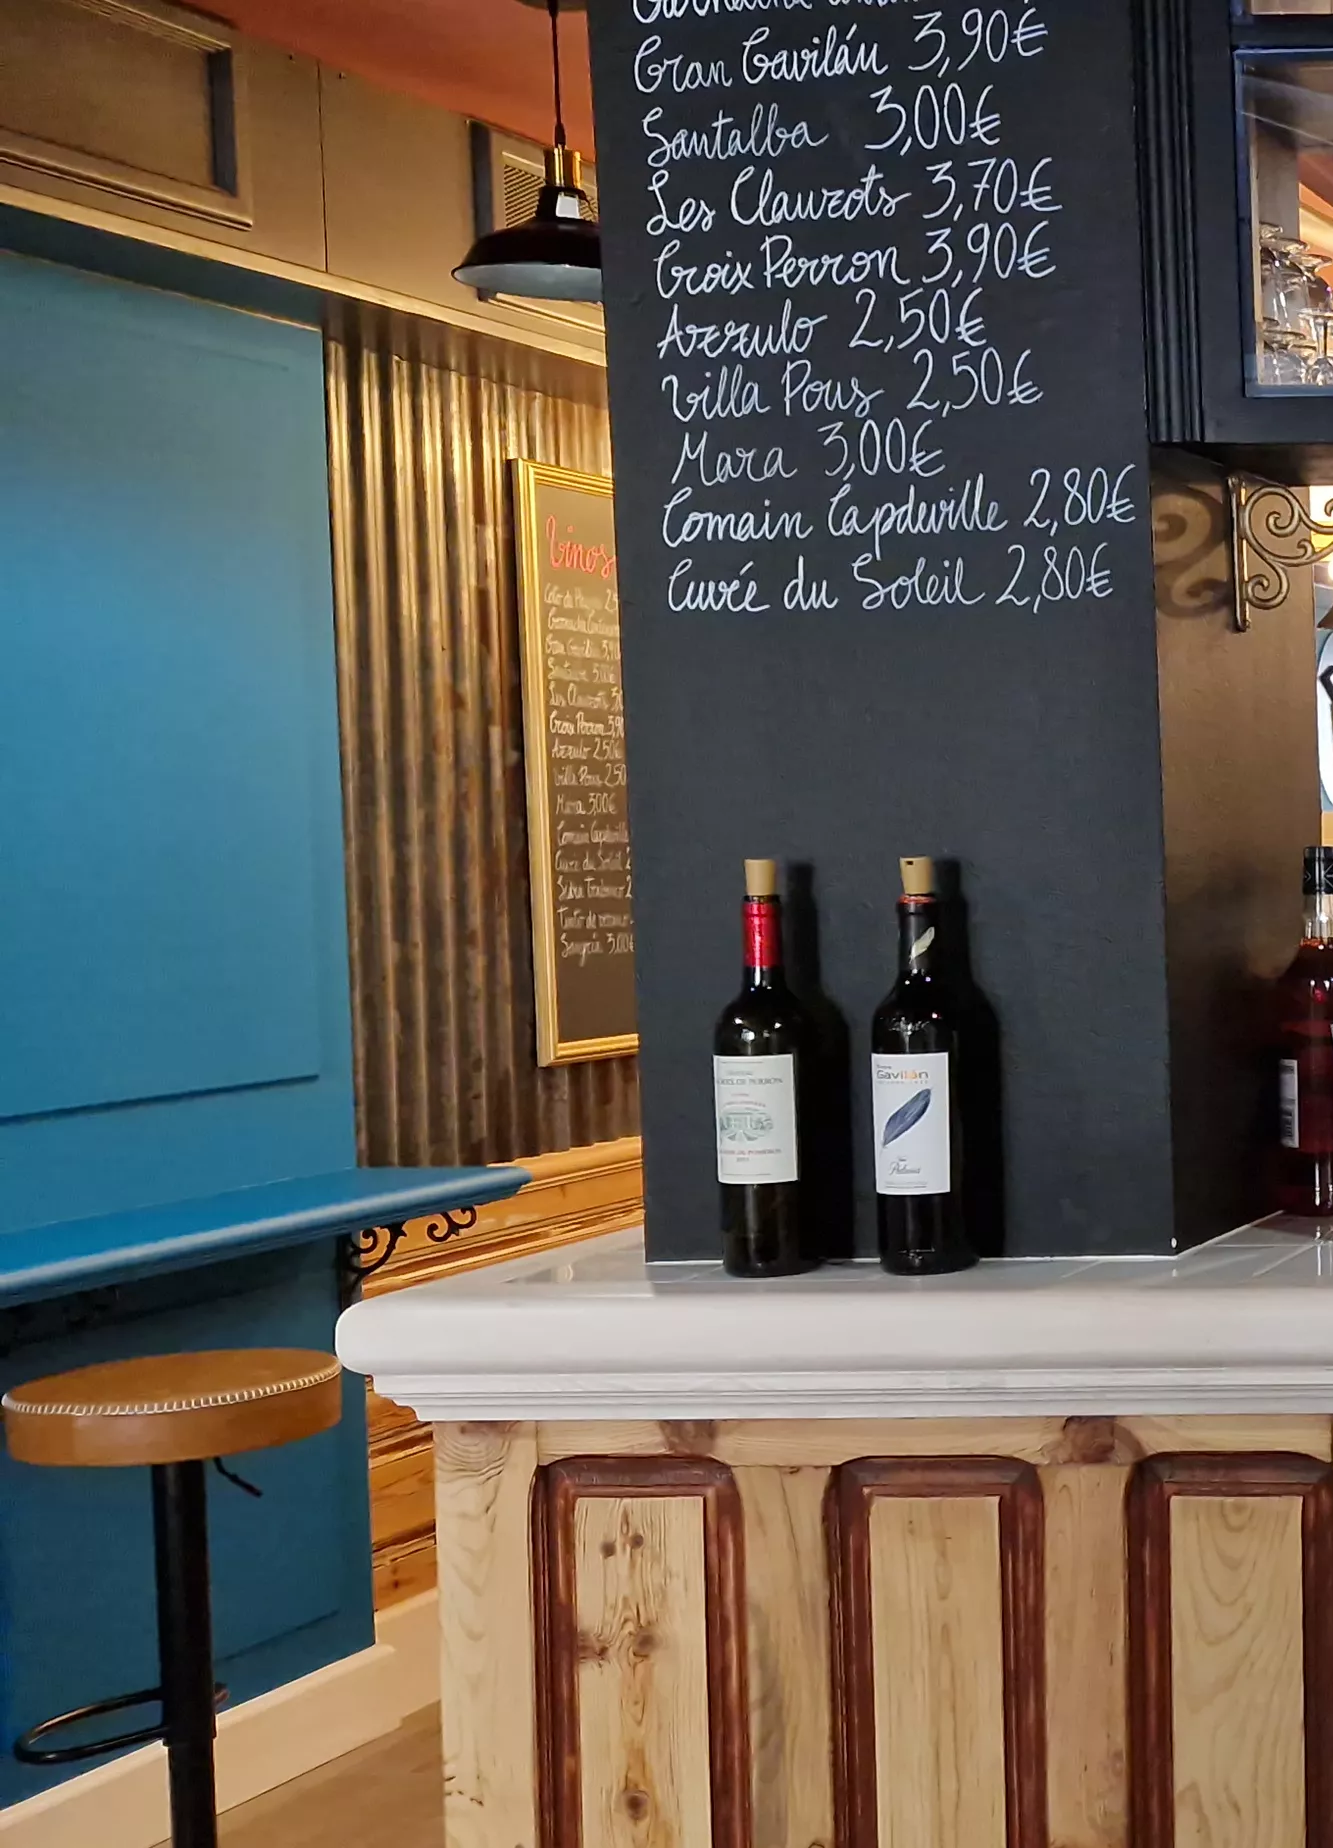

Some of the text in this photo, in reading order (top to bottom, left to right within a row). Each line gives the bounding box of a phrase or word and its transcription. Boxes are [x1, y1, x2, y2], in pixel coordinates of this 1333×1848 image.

[634, 8, 1049, 93] Gran Gavilán 3,90€
[643, 83, 1001, 167] Santalba 3,00€
[646, 170, 715, 235] Les
[921, 158, 1062, 220] 3,70€
[655, 220, 1057, 298] Croix Perron 3,90€
[849, 287, 987, 352] 2,50€
[662, 363, 770, 421] Villa
[907, 347, 1044, 418] 2,50€
[670, 418, 946, 487] Mara 3,00€
[546, 515, 618, 579] Vinos
[828, 474, 1008, 562] Capdeville
[1023, 464, 1137, 538] 2,80€
[784, 555, 838, 611] du
[851, 552, 986, 610] Soleil
[996, 543, 1115, 615] 2,80€
[876, 1070, 929, 1080] Gavilán
